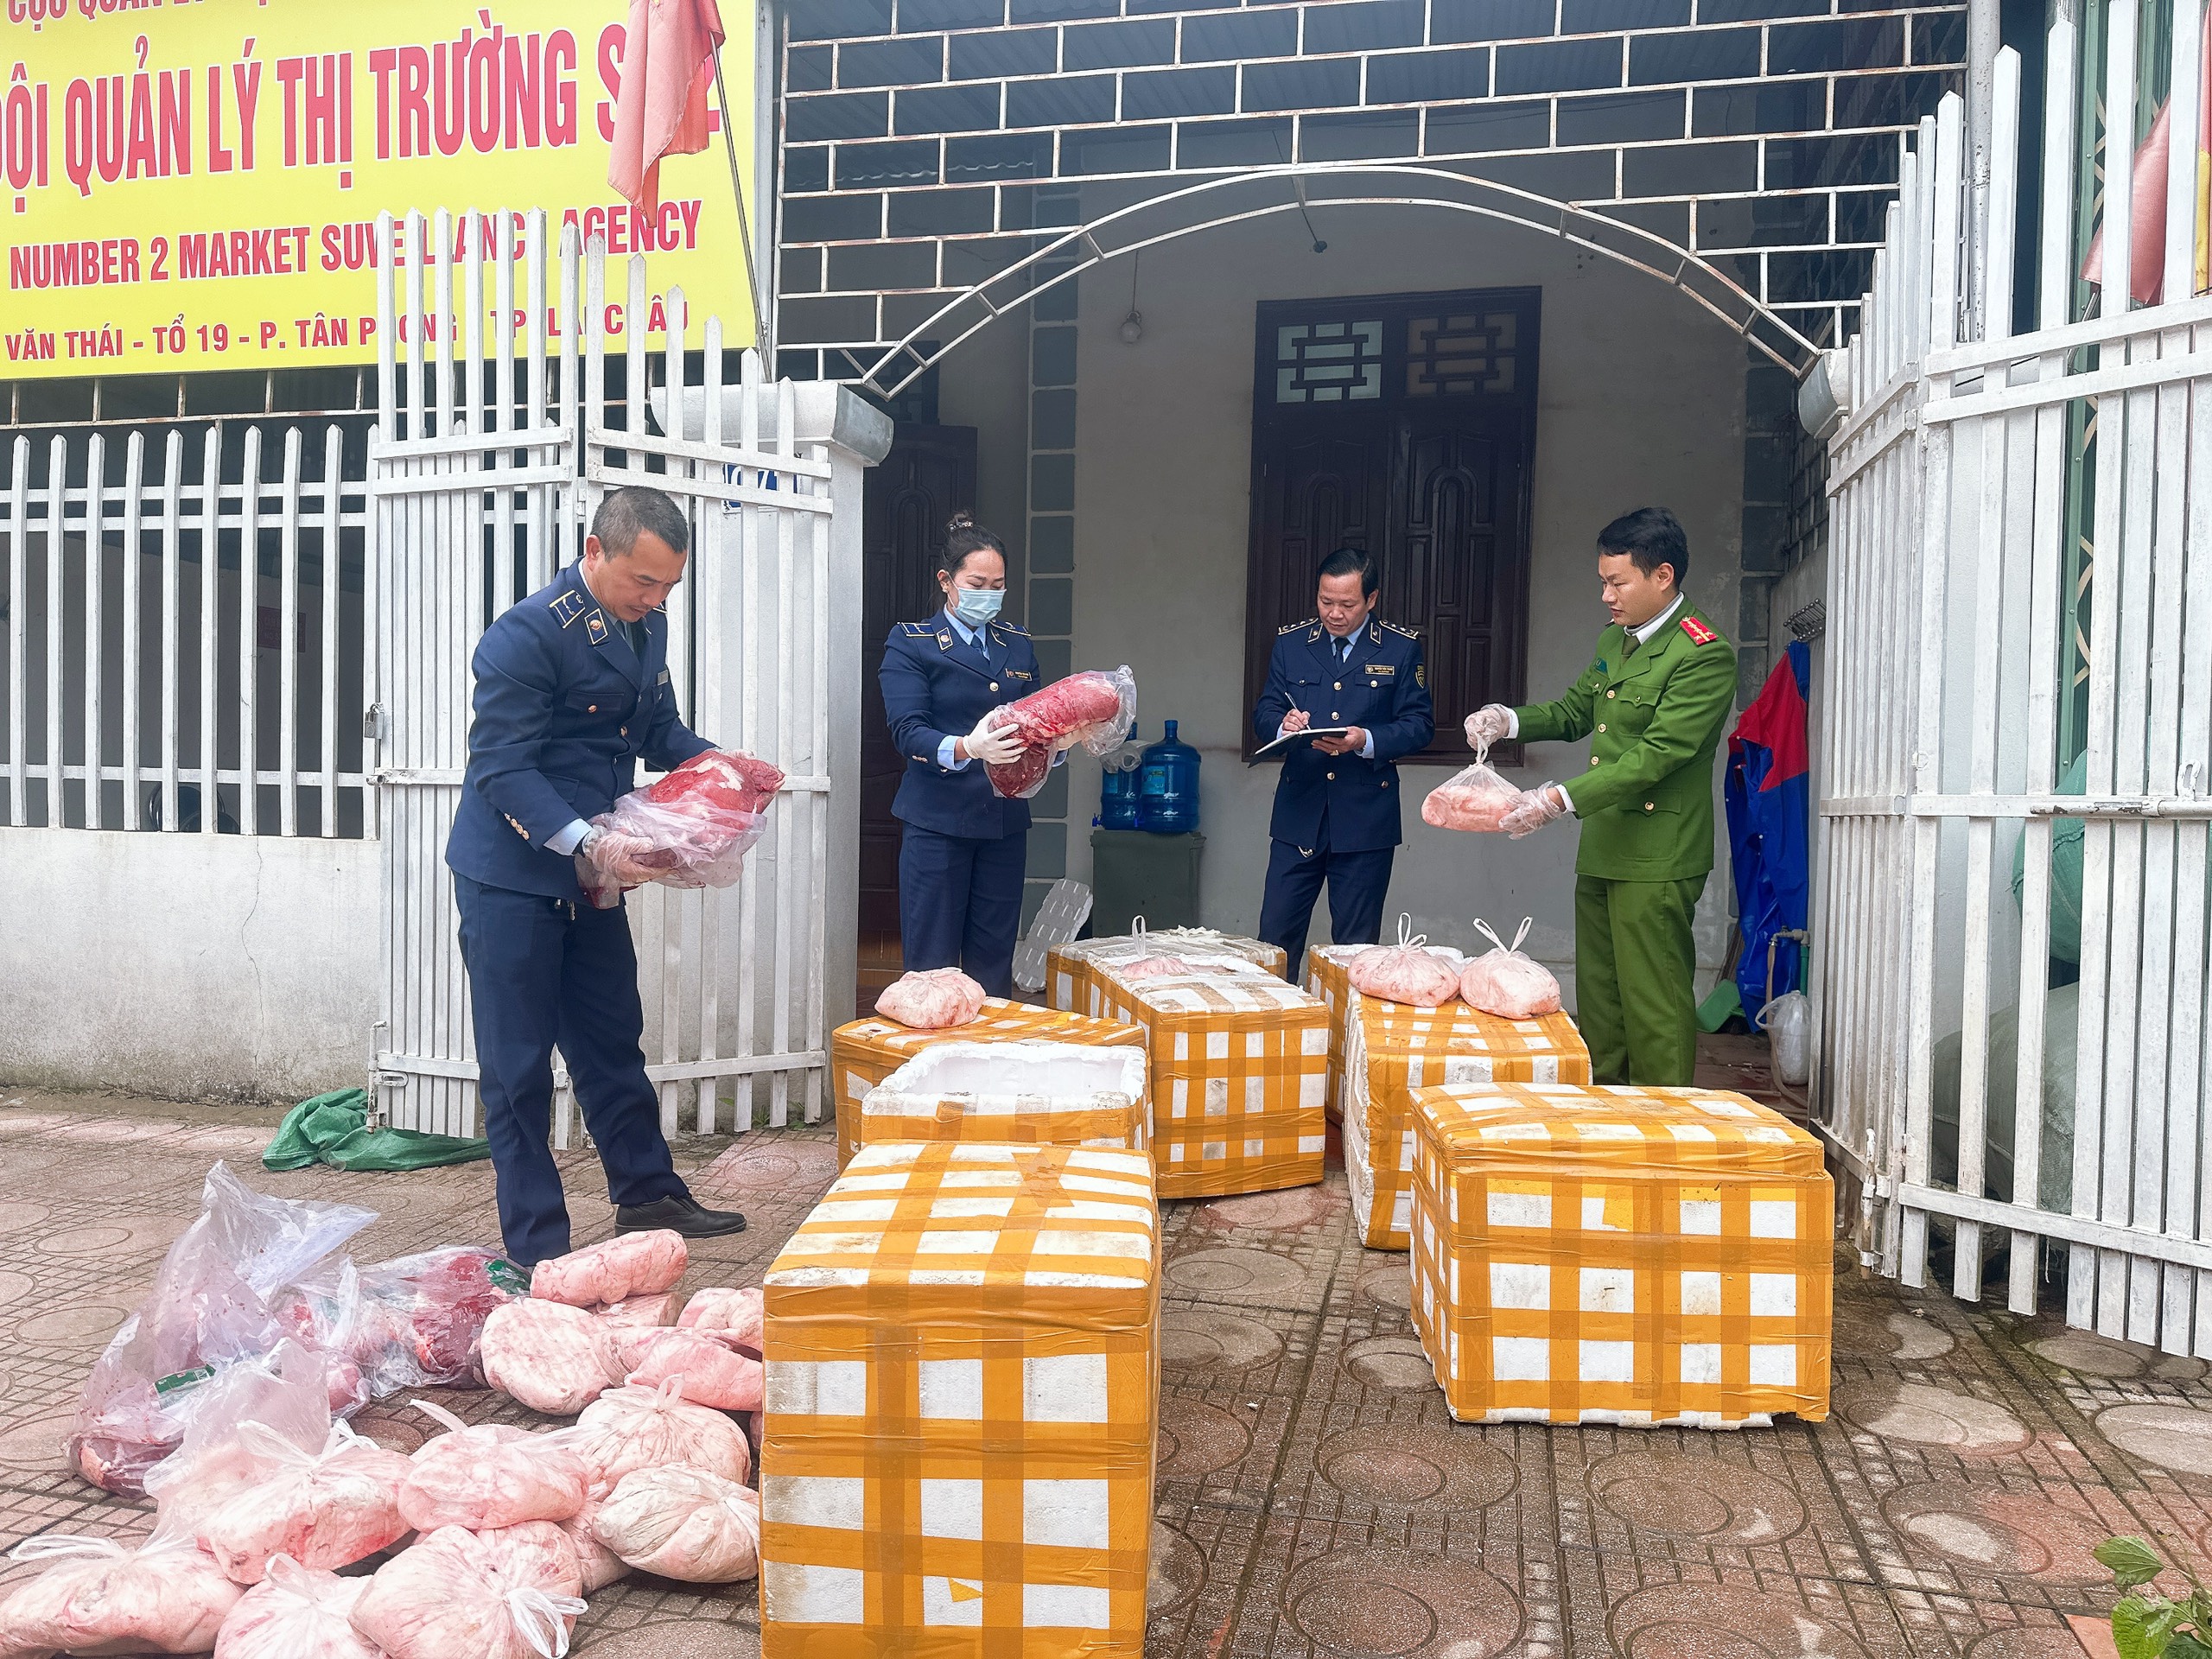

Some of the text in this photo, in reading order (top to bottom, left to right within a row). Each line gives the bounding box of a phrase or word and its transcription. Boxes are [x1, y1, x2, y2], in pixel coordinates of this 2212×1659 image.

[0, 63, 48, 213] ỘI
[66, 35, 190, 196] QUẢN
[209, 38, 262, 172] LÝ
[277, 53, 352, 188] THỊ
[370, 10, 576, 159] TRƯỜNG
[10, 238, 140, 289] NUMBER
[150, 237, 168, 281] 2
[179, 226, 311, 278] MARKET
[5, 327, 54, 360] VĂN
[64, 323, 122, 358] THÁI
[153, 313, 186, 353] TỔ
[197, 324, 228, 352] 19
[260, 321, 286, 349] P.
[296, 312, 347, 347] TÂN
